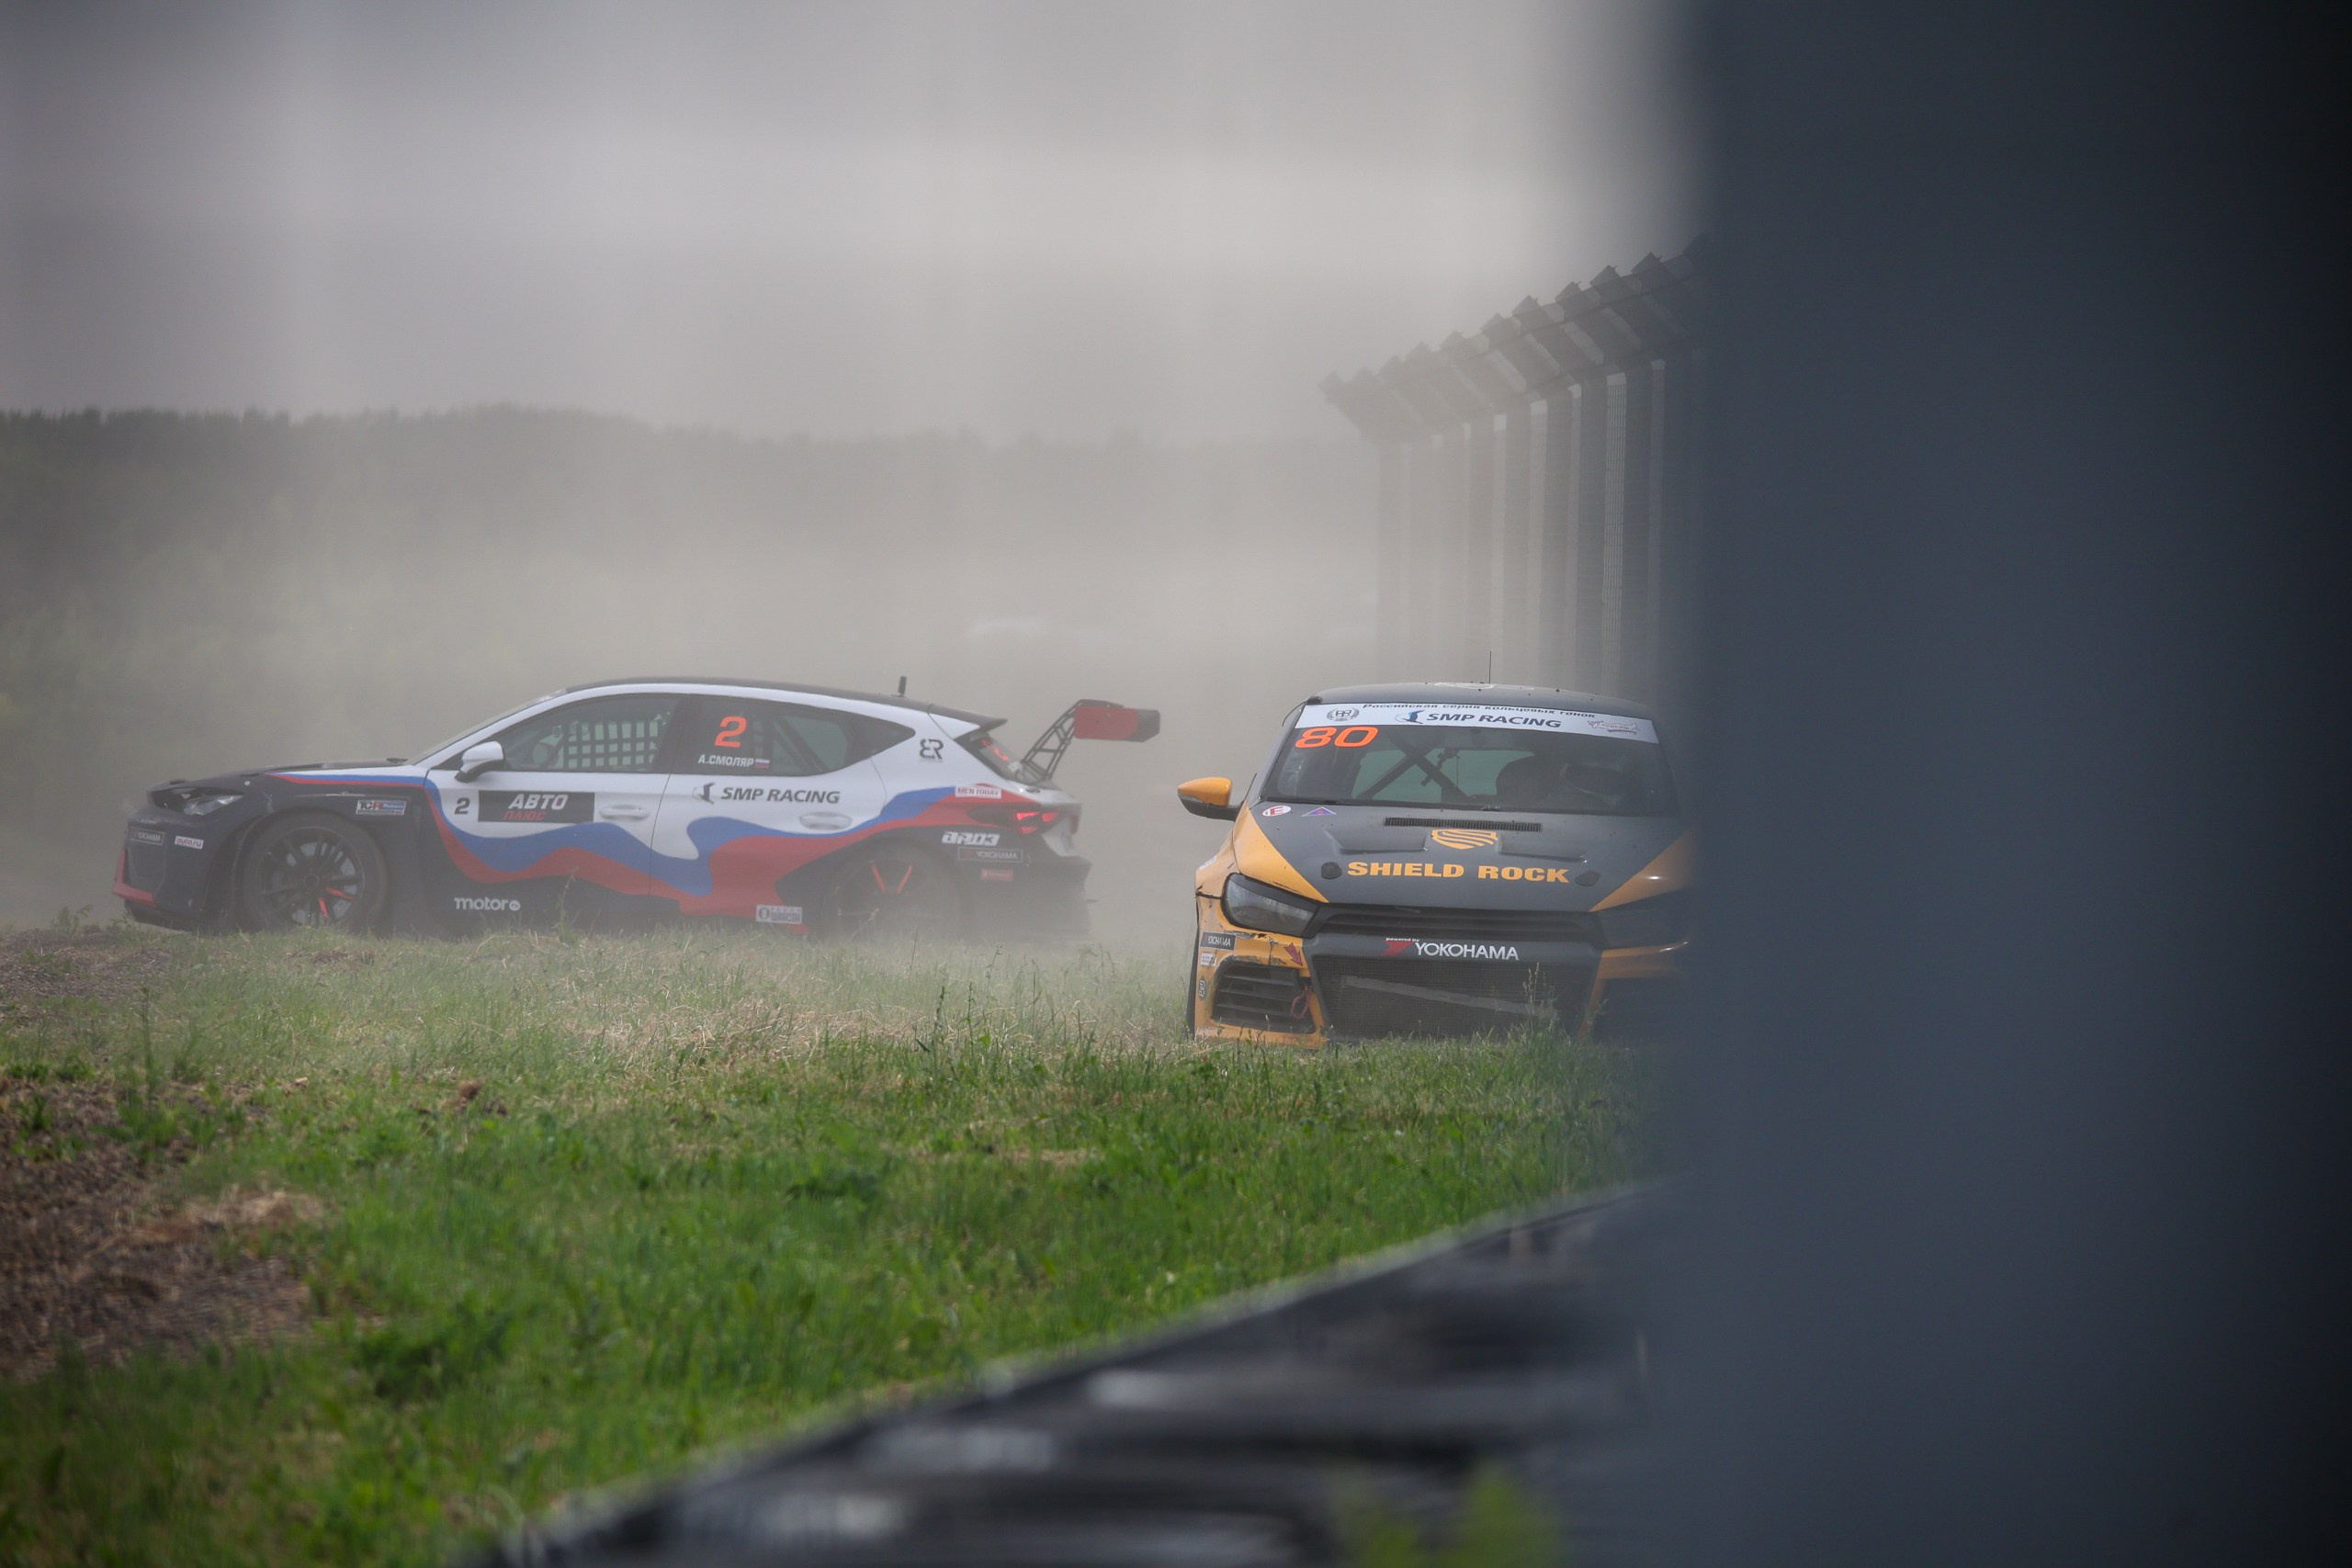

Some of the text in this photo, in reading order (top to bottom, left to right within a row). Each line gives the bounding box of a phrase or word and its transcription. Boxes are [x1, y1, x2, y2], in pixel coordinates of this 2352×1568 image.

[1485, 705, 1555, 714] кольцевых
[1427, 713, 1562, 728] SMP RACING
[714, 716, 748, 748] 2
[1295, 726, 1378, 749] 80
[508, 794, 569, 810] АВТО
[721, 786, 840, 804] SMP RACING
[455, 797, 470, 815] 2
[503, 810, 546, 821] ПЛЮС
[176, 838, 202, 847] auto.ru
[1347, 862, 1569, 883] SHIELD ROCK
[1414, 942, 1519, 961] YOKOHAMA
